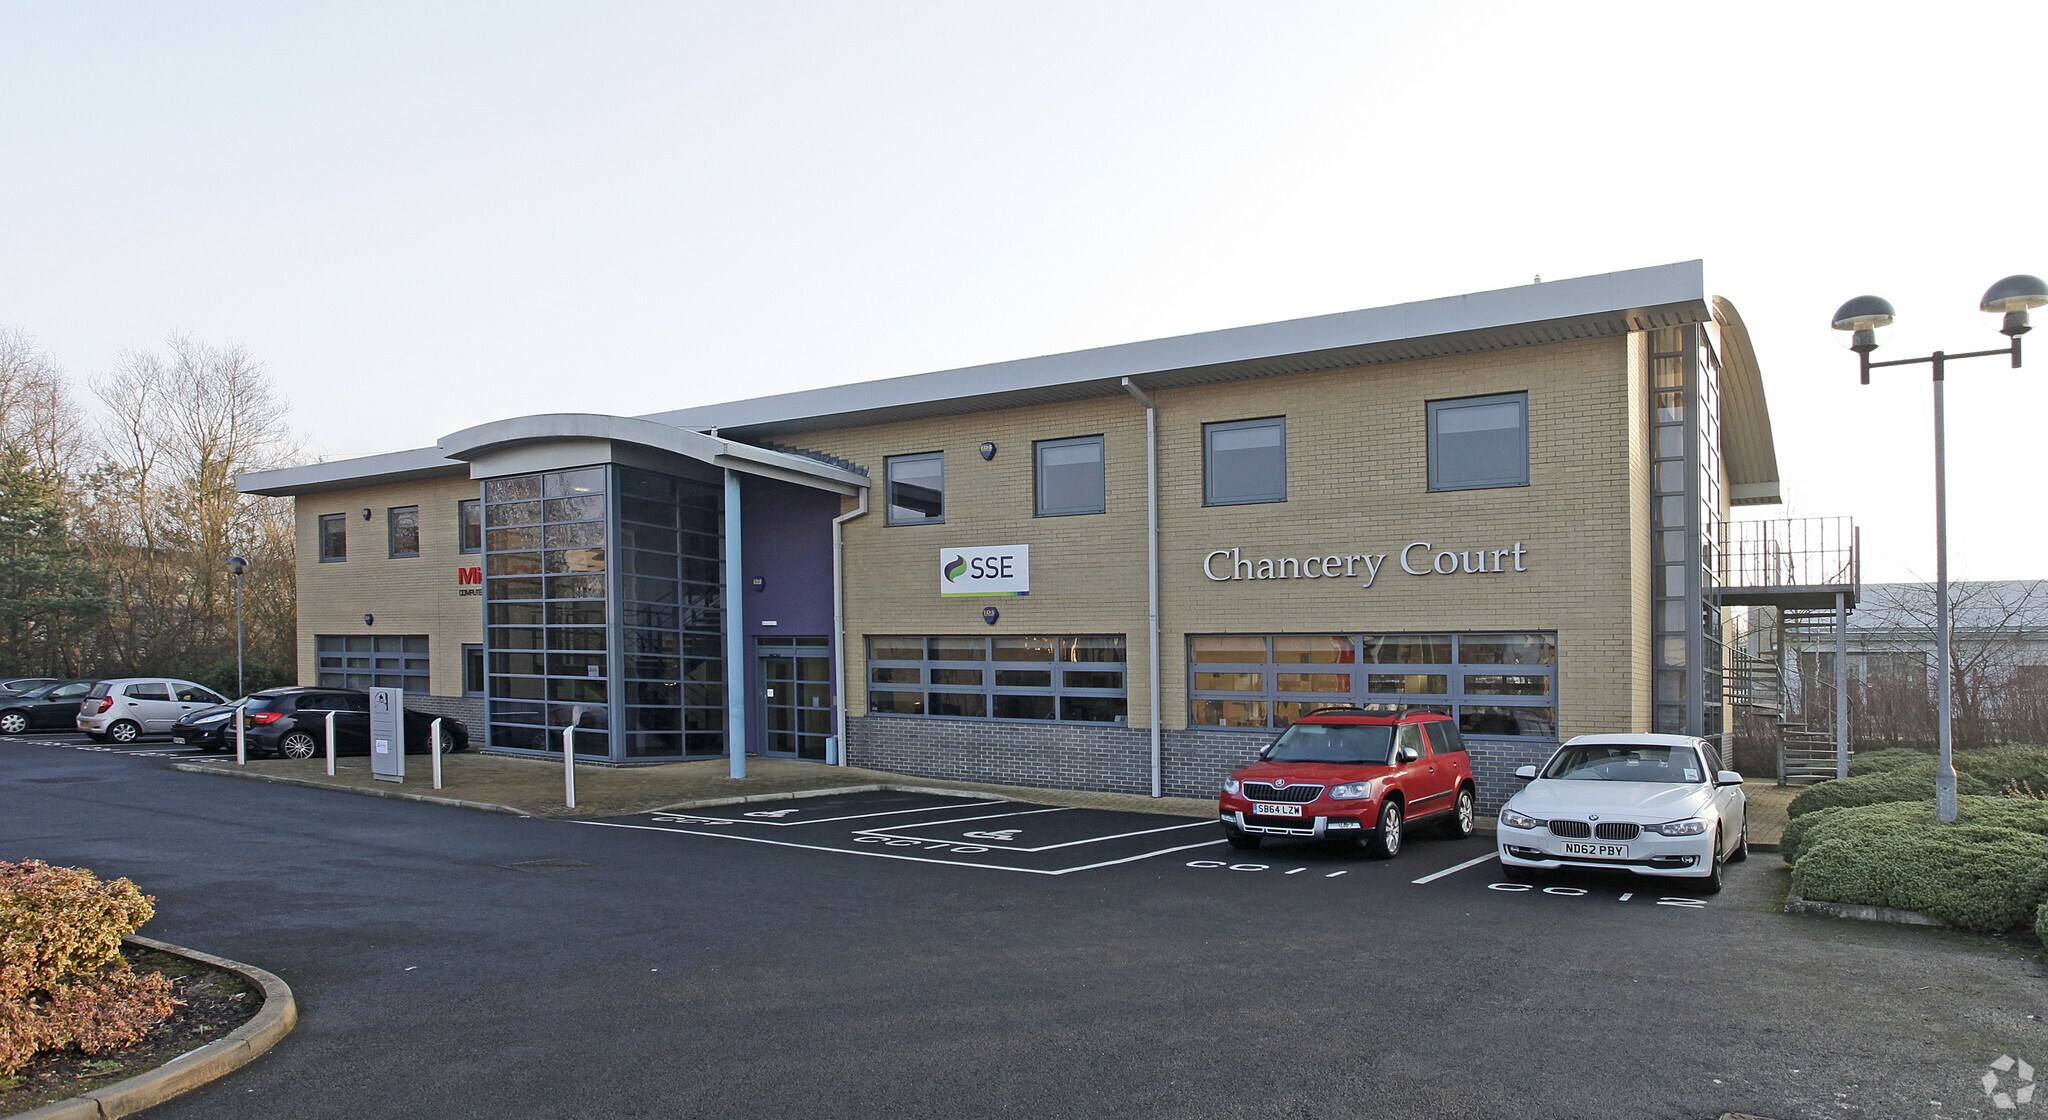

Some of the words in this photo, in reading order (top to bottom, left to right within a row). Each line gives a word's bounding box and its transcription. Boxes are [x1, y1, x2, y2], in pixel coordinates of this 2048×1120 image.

[970, 556, 1014, 579] SSE
[1203, 547, 1387, 588] Chancery
[1400, 541, 1528, 576] Court
[458, 567, 483, 585] Mi
[1258, 804, 1281, 814] SB64
[1282, 806, 1301, 815] LZW
[1565, 843, 1597, 855] ND62
[1599, 846, 1624, 857] PBY
